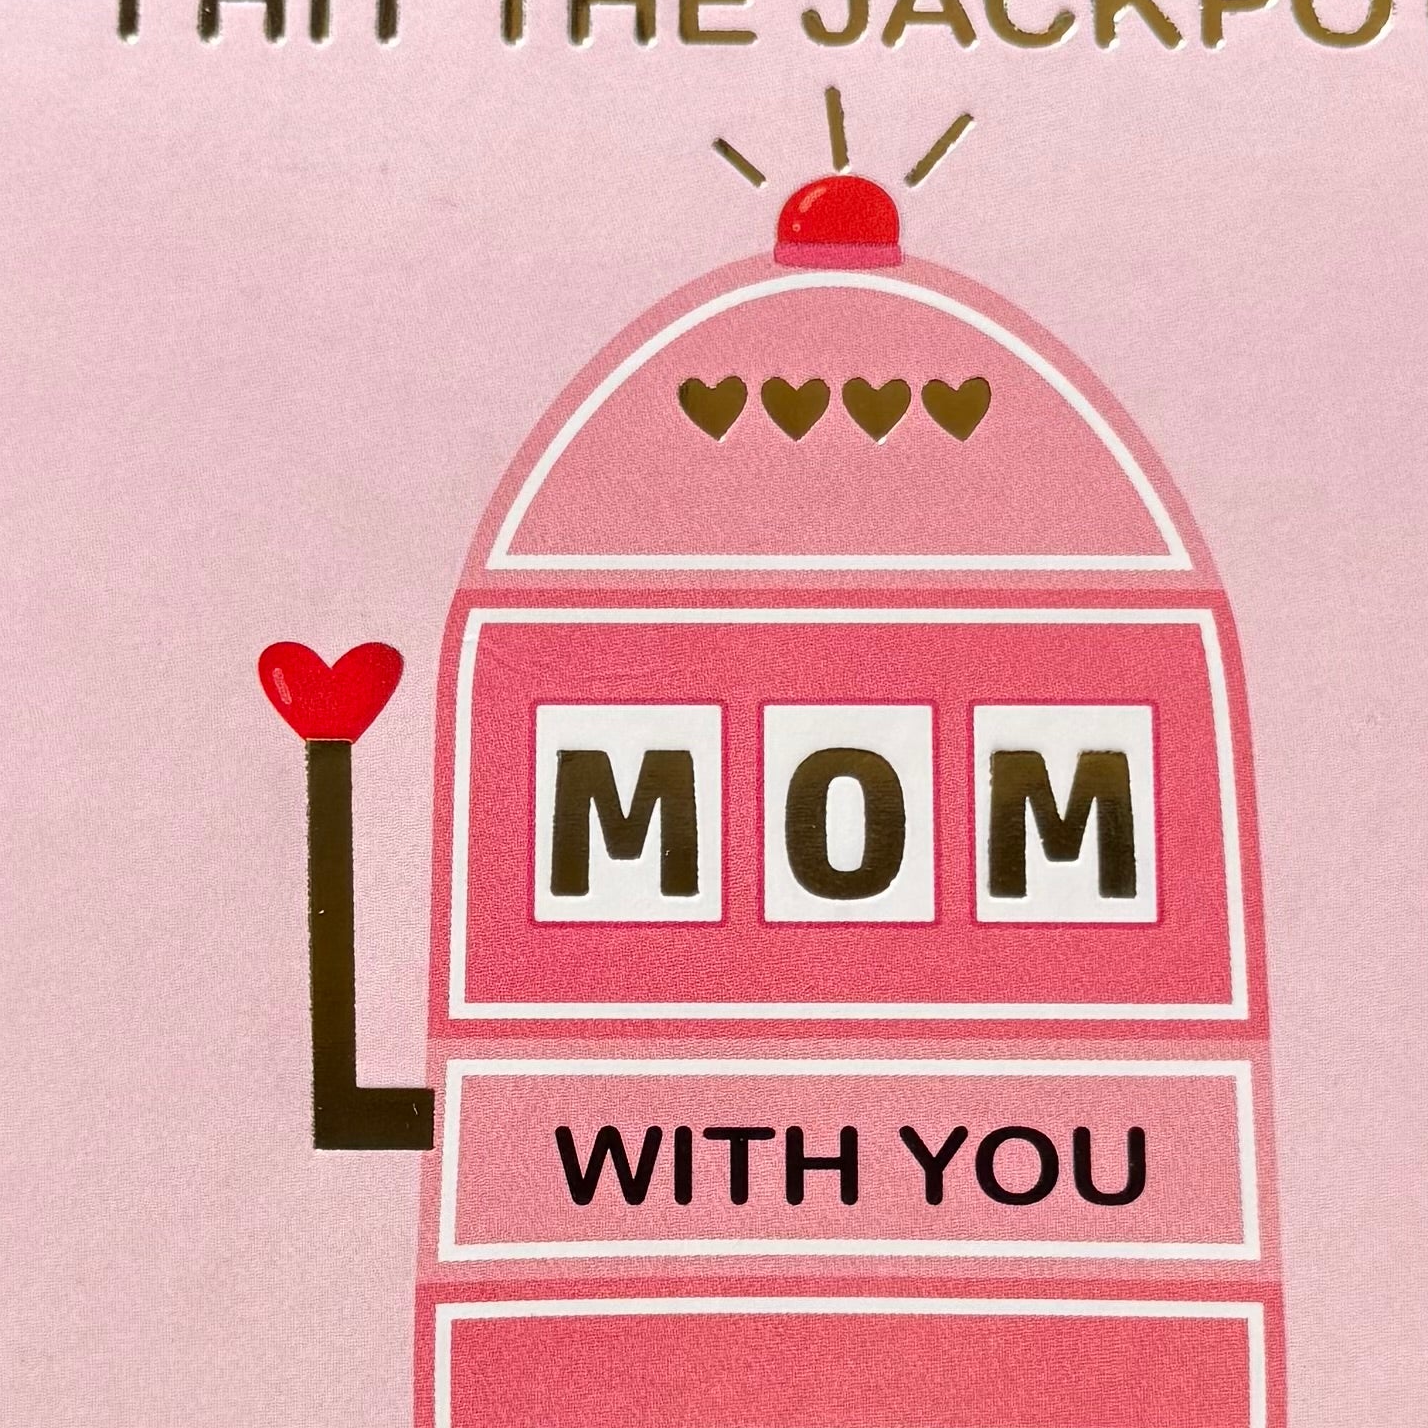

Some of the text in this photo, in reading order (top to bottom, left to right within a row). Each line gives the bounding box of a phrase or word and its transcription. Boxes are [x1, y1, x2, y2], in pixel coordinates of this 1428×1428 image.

[550, 747, 1138, 900] MOM
[554, 1125, 1146, 1206] WITH YOU
